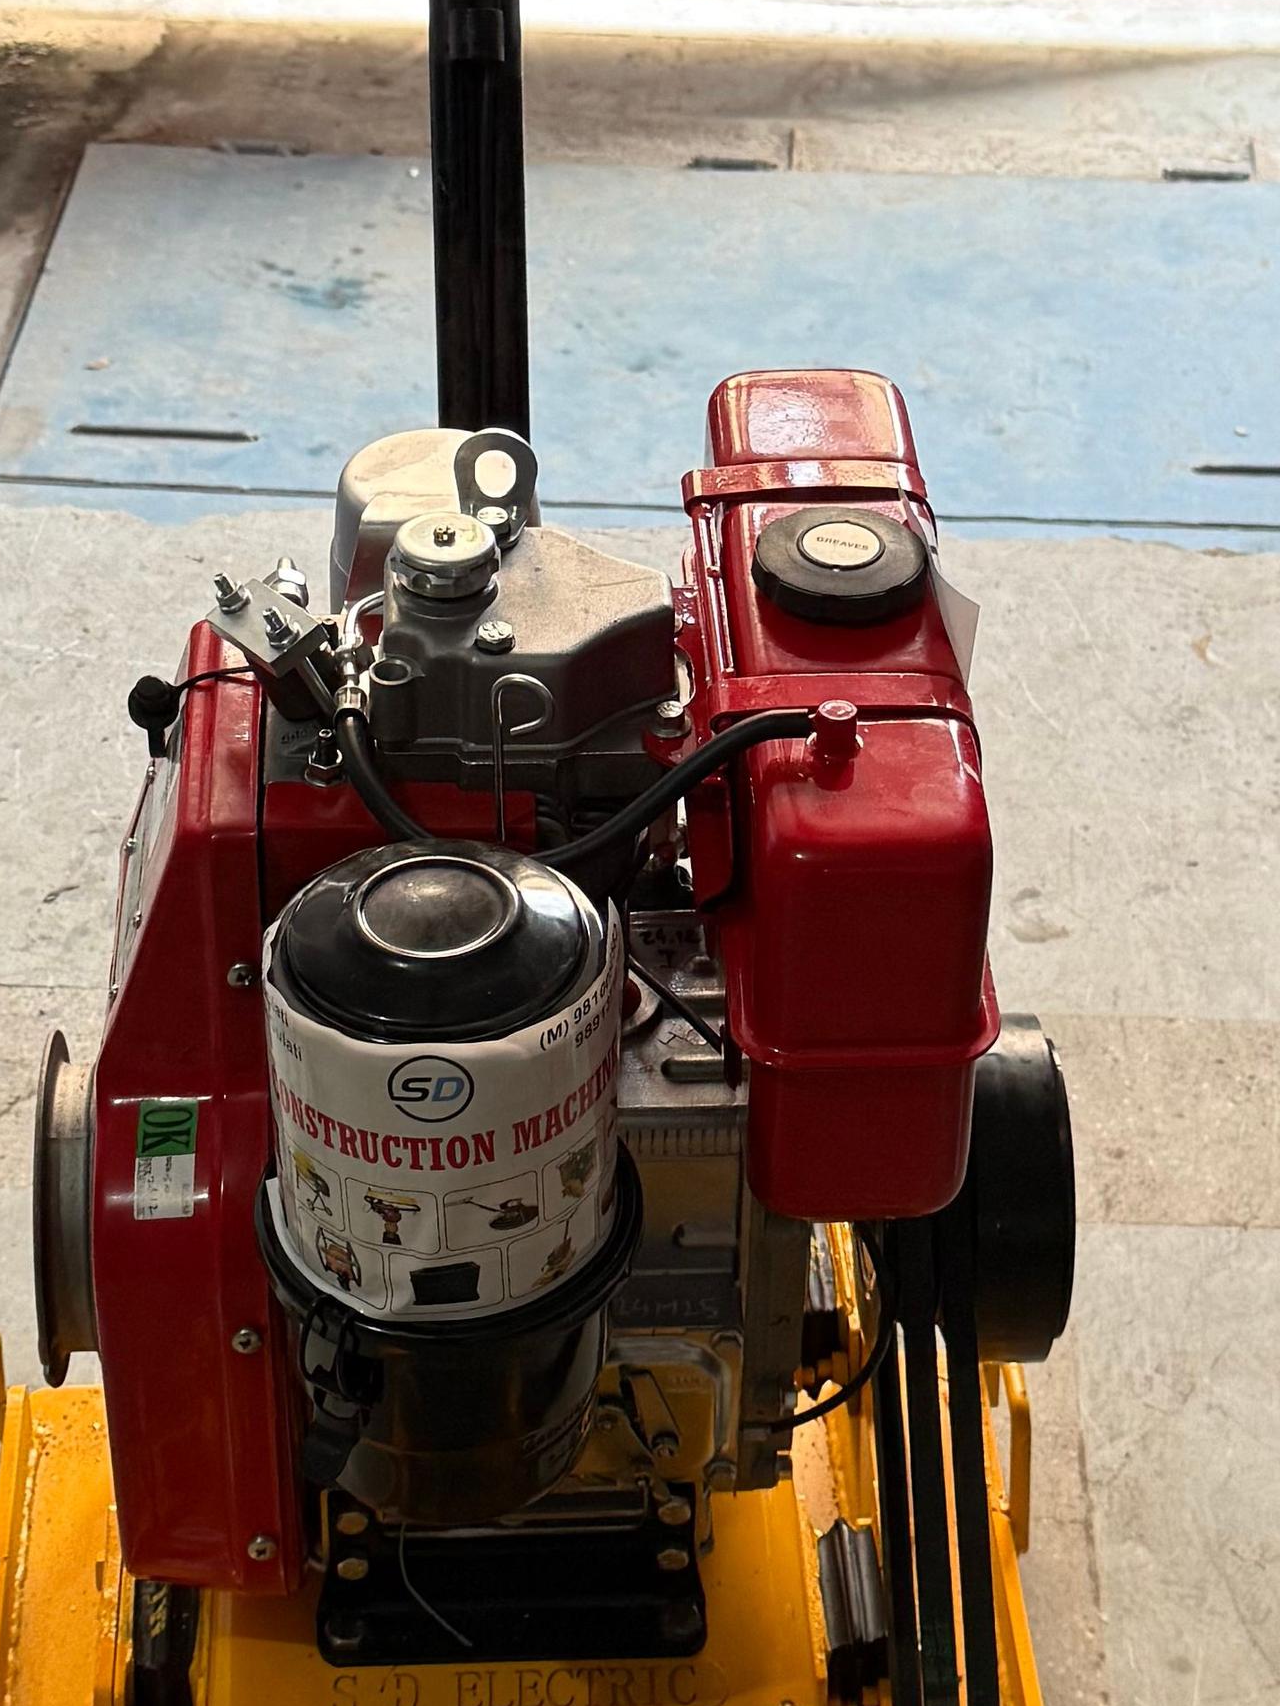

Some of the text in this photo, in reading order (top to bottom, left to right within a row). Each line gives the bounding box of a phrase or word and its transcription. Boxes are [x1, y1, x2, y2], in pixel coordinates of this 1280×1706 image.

[816, 536, 869, 551] GREAVES
[540, 1019, 569, 1051] (M)
[142, 1106, 193, 1153] OK
